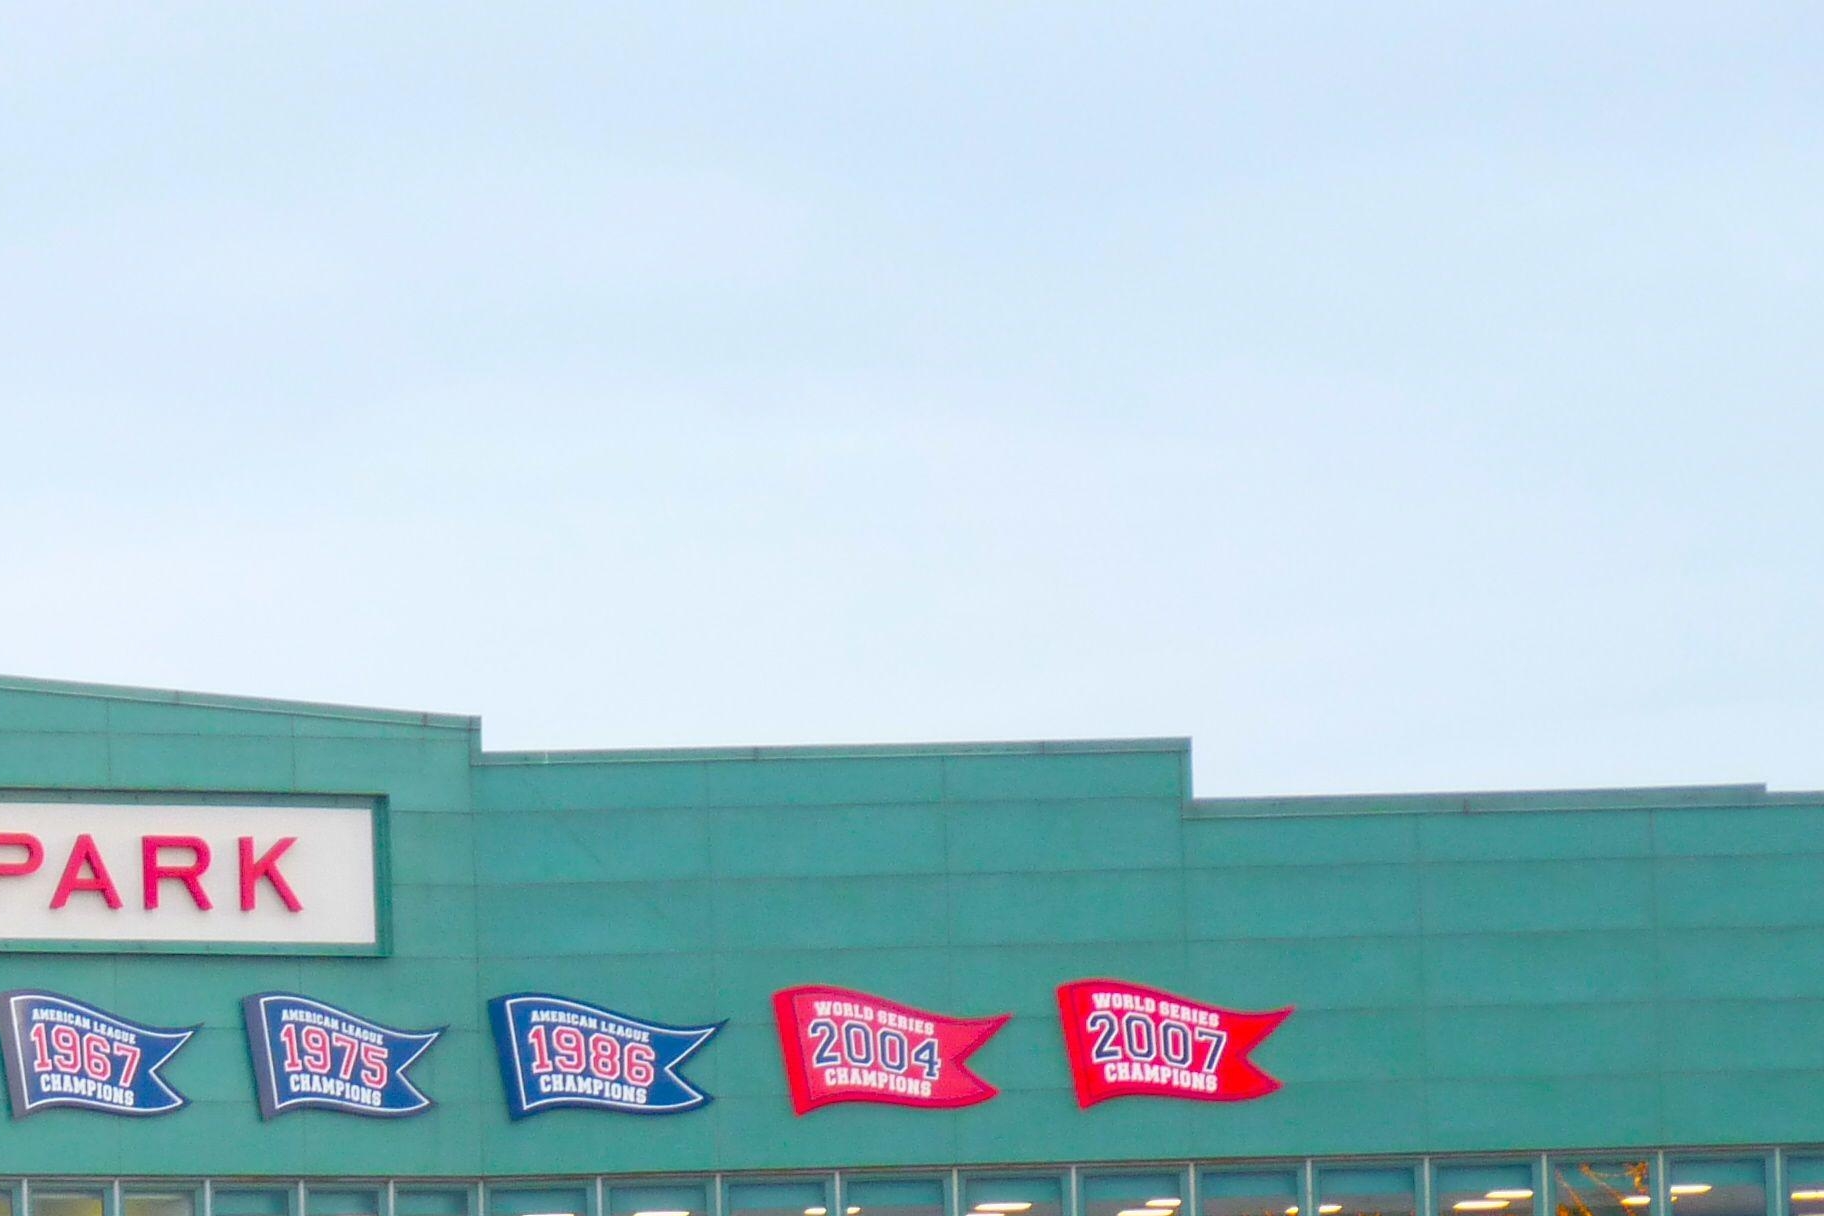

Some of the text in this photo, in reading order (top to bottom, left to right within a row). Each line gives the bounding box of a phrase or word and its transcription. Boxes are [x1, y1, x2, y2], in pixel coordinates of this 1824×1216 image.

[32, 1008, 136, 1044] AMERICAN LEAGUE
[281, 1009, 384, 1045] AMERICAN LEAGUE
[531, 1010, 649, 1042] AMERICAN LEAGUE
[814, 1001, 934, 1036] WORLD SERIES
[1092, 992, 1219, 1027] WORLD SERIES
[30, 1022, 140, 1088] 1967
[281, 1023, 388, 1089] 1975
[528, 1025, 655, 1087] 1986
[809, 1018, 941, 1080] 2004
[1087, 1010, 1226, 1073] 2007
[40, 1074, 134, 1106] CHAMPIONS
[289, 1073, 382, 1106] CHAMPIONS
[540, 1074, 647, 1104] CHAMPIONS
[825, 1067, 931, 1097] CHAMPIONS
[1104, 1062, 1218, 1093] CHAMPIONS
